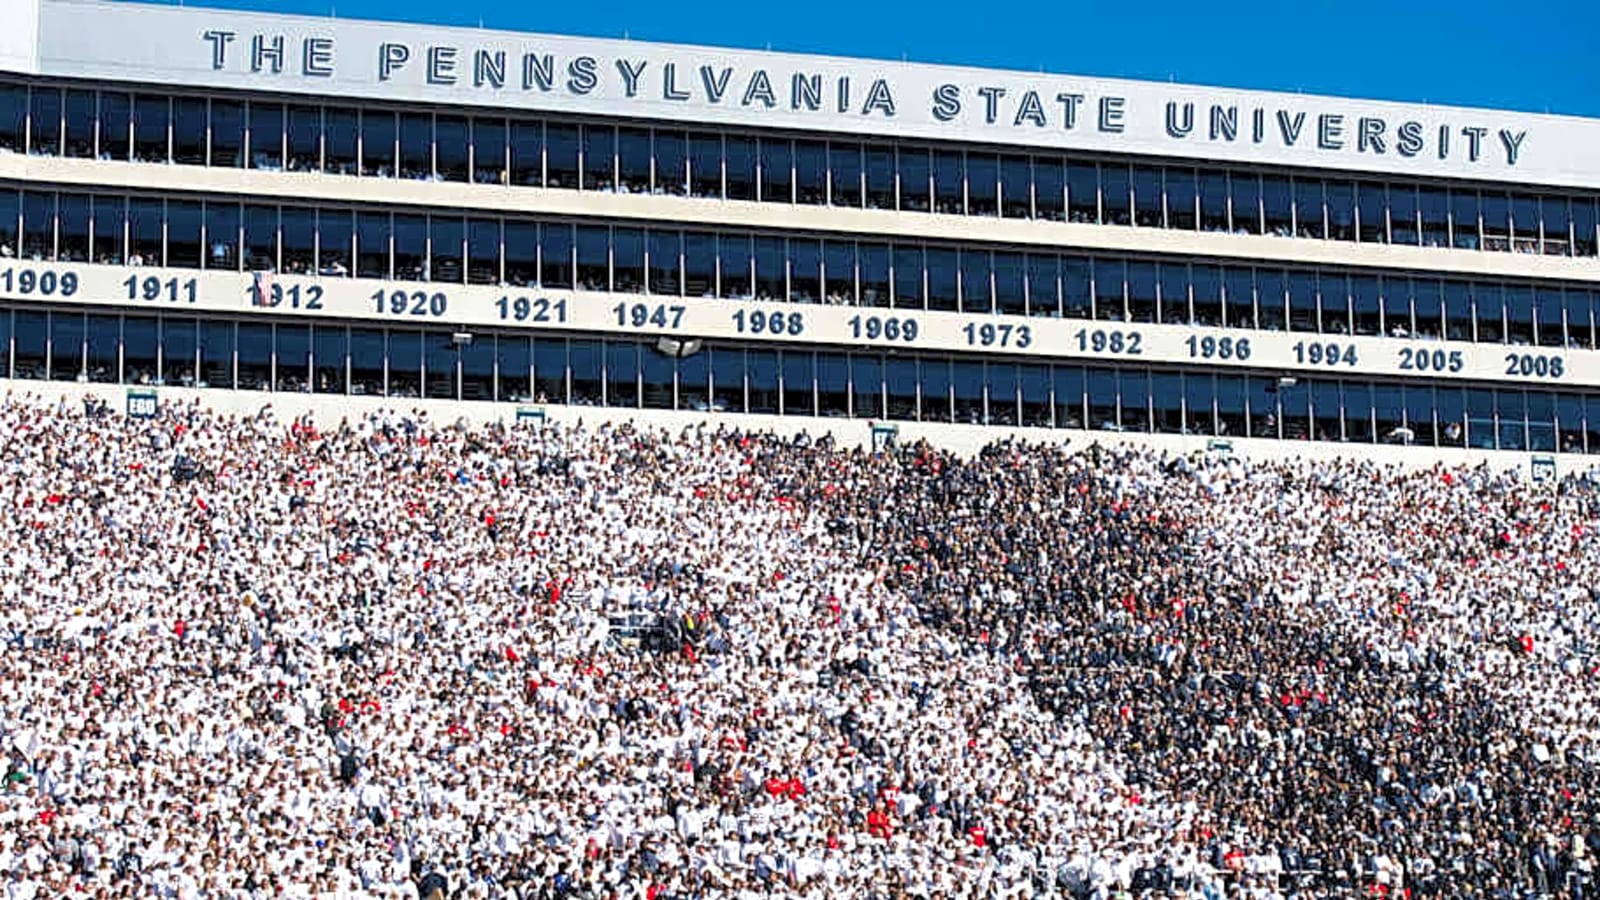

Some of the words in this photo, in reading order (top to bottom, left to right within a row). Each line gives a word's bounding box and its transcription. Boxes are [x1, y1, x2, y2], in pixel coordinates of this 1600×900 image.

[203, 30, 335, 77] THE
[378, 42, 896, 117] PENNSYLVANIA
[931, 83, 1126, 134] STATE
[1165, 101, 1527, 166] UNIVERSITY
[0, 267, 78, 297] 1909
[123, 274, 197, 303] 1911
[371, 289, 447, 317] 1920
[495, 296, 567, 323] 1921
[612, 303, 686, 329] 1947
[732, 309, 804, 336] 1968
[847, 316, 918, 342] 1969
[962, 323, 1032, 349] 1973
[1074, 329, 1142, 355] 1982
[1185, 336, 1251, 361] 1986
[1292, 342, 1358, 367] 1994
[1398, 348, 1463, 373] 2005
[1504, 354, 1564, 379] 2008
